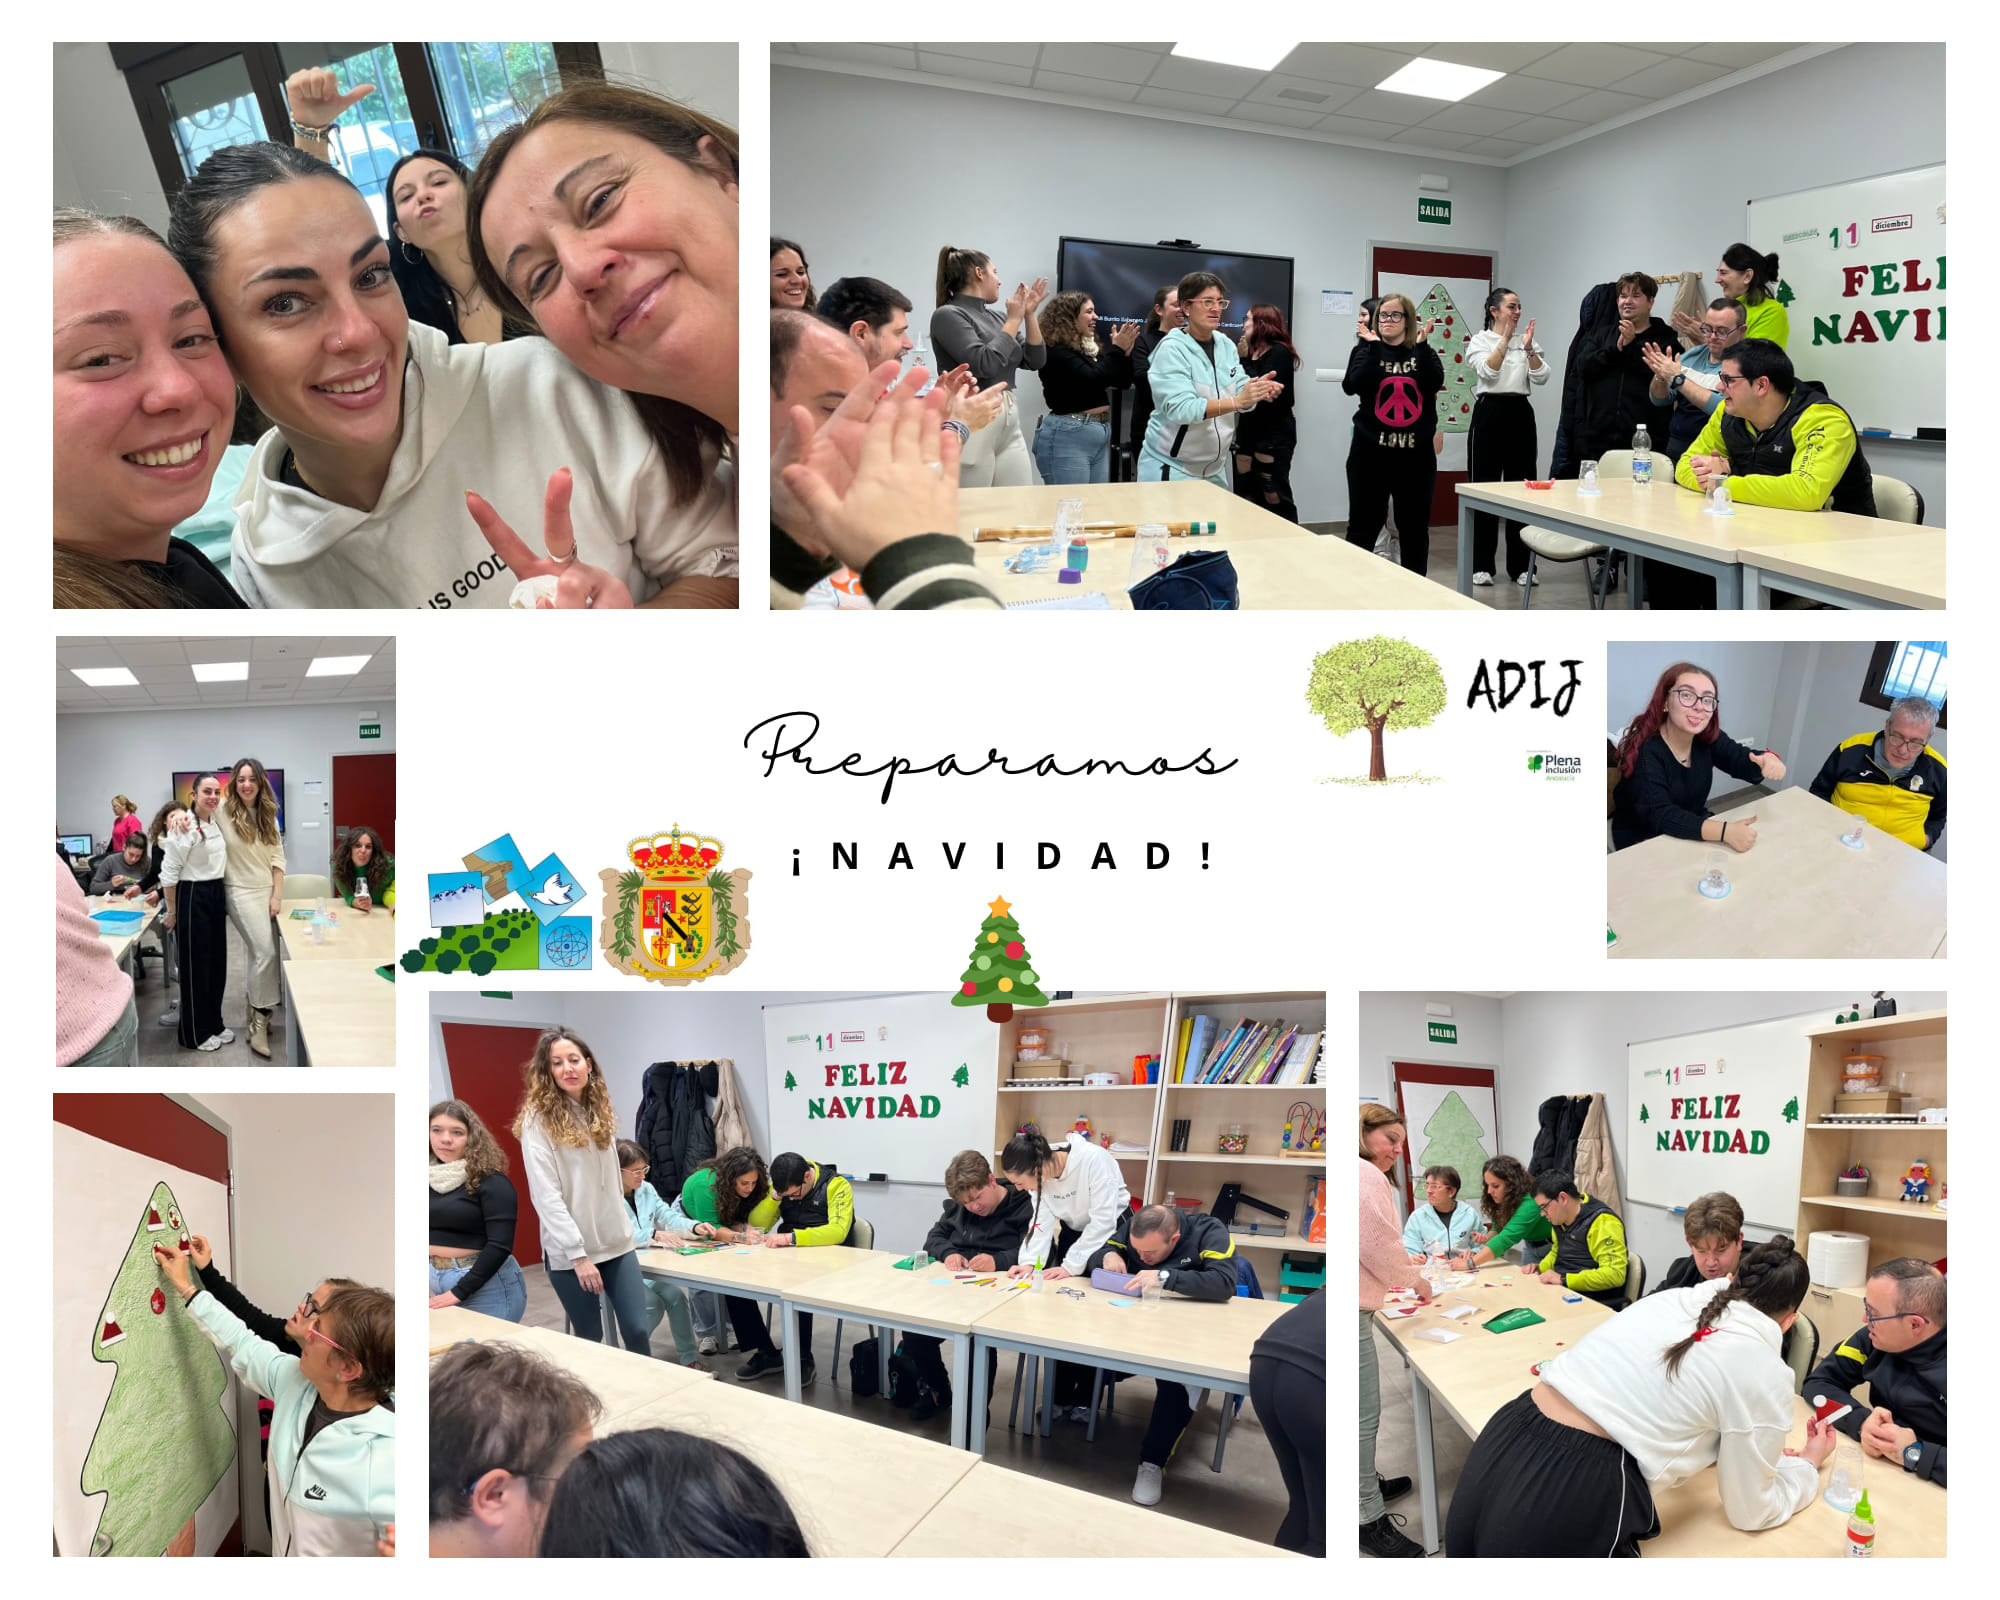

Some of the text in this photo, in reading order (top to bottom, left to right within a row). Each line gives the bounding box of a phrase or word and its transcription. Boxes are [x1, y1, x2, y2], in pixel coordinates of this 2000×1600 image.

[1420, 205, 1449, 217] SALIDA
[1875, 219, 1908, 229] diciembre
[1379, 432, 1415, 448] LOVE
[1430, 1028, 1456, 1039] SALIDA
[825, 1061, 907, 1087] FELIZ
[808, 1093, 941, 1119] NAVIDAD
[1670, 1094, 1741, 1120] FELIZ
[1656, 1128, 1770, 1155] NAVIDAD
